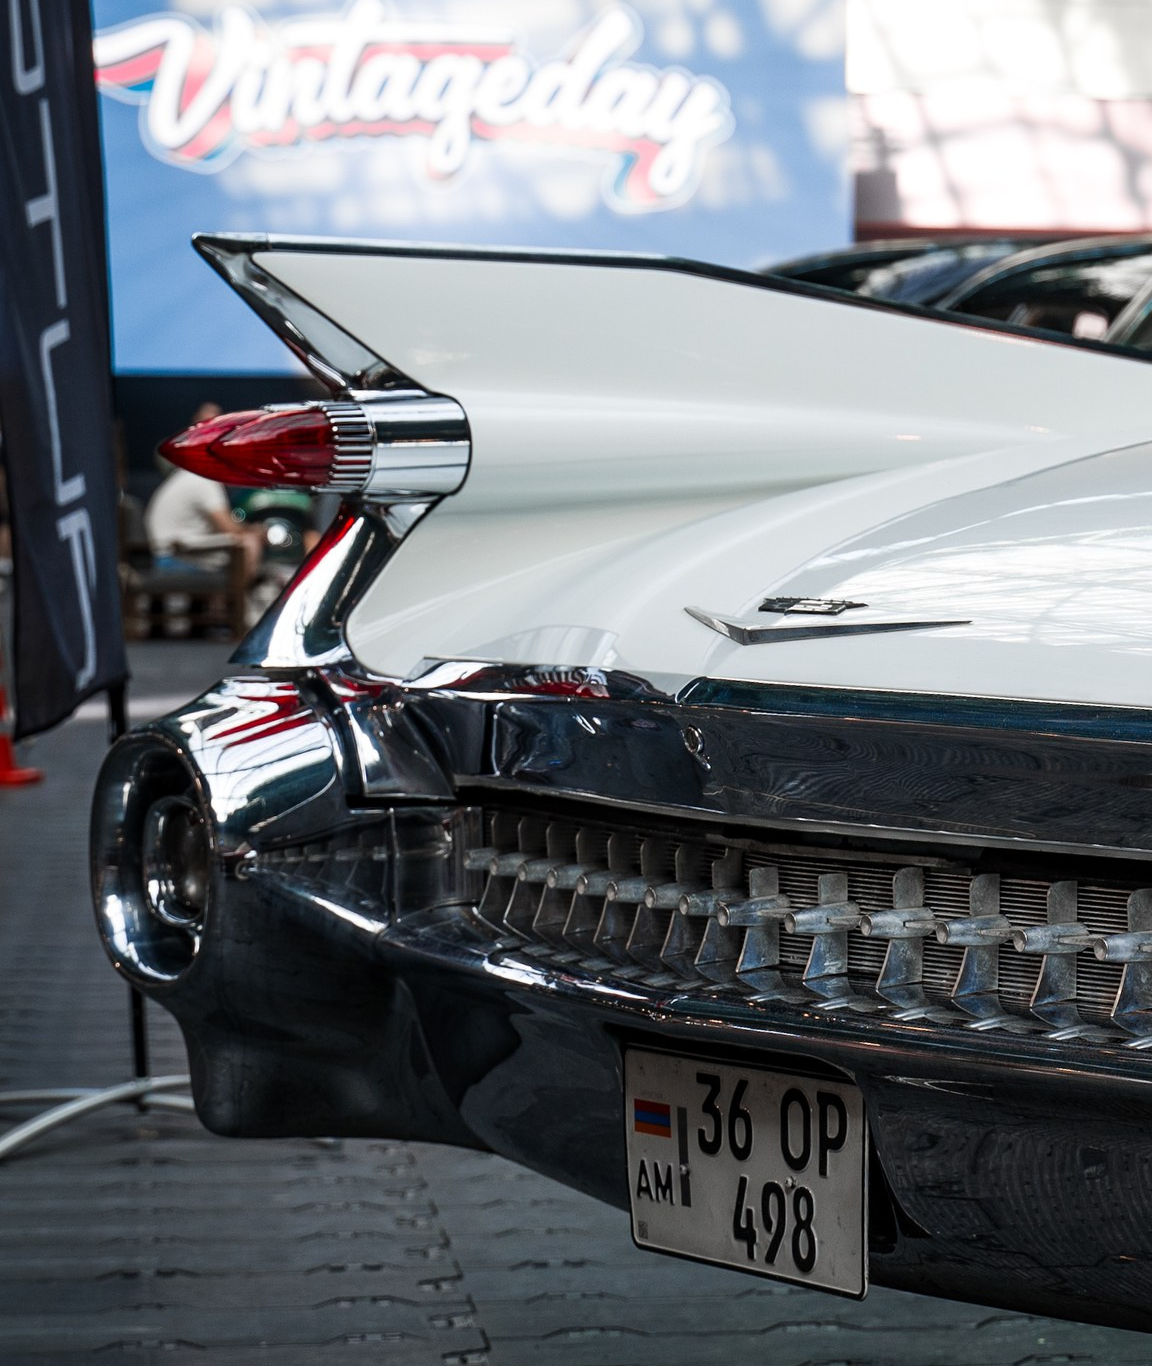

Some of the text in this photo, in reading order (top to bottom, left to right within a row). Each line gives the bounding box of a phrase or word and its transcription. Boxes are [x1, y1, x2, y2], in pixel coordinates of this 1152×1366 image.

[696, 1072, 848, 1177] 36 OP
[637, 1159, 674, 1205] AM
[733, 1175, 818, 1273] 498
